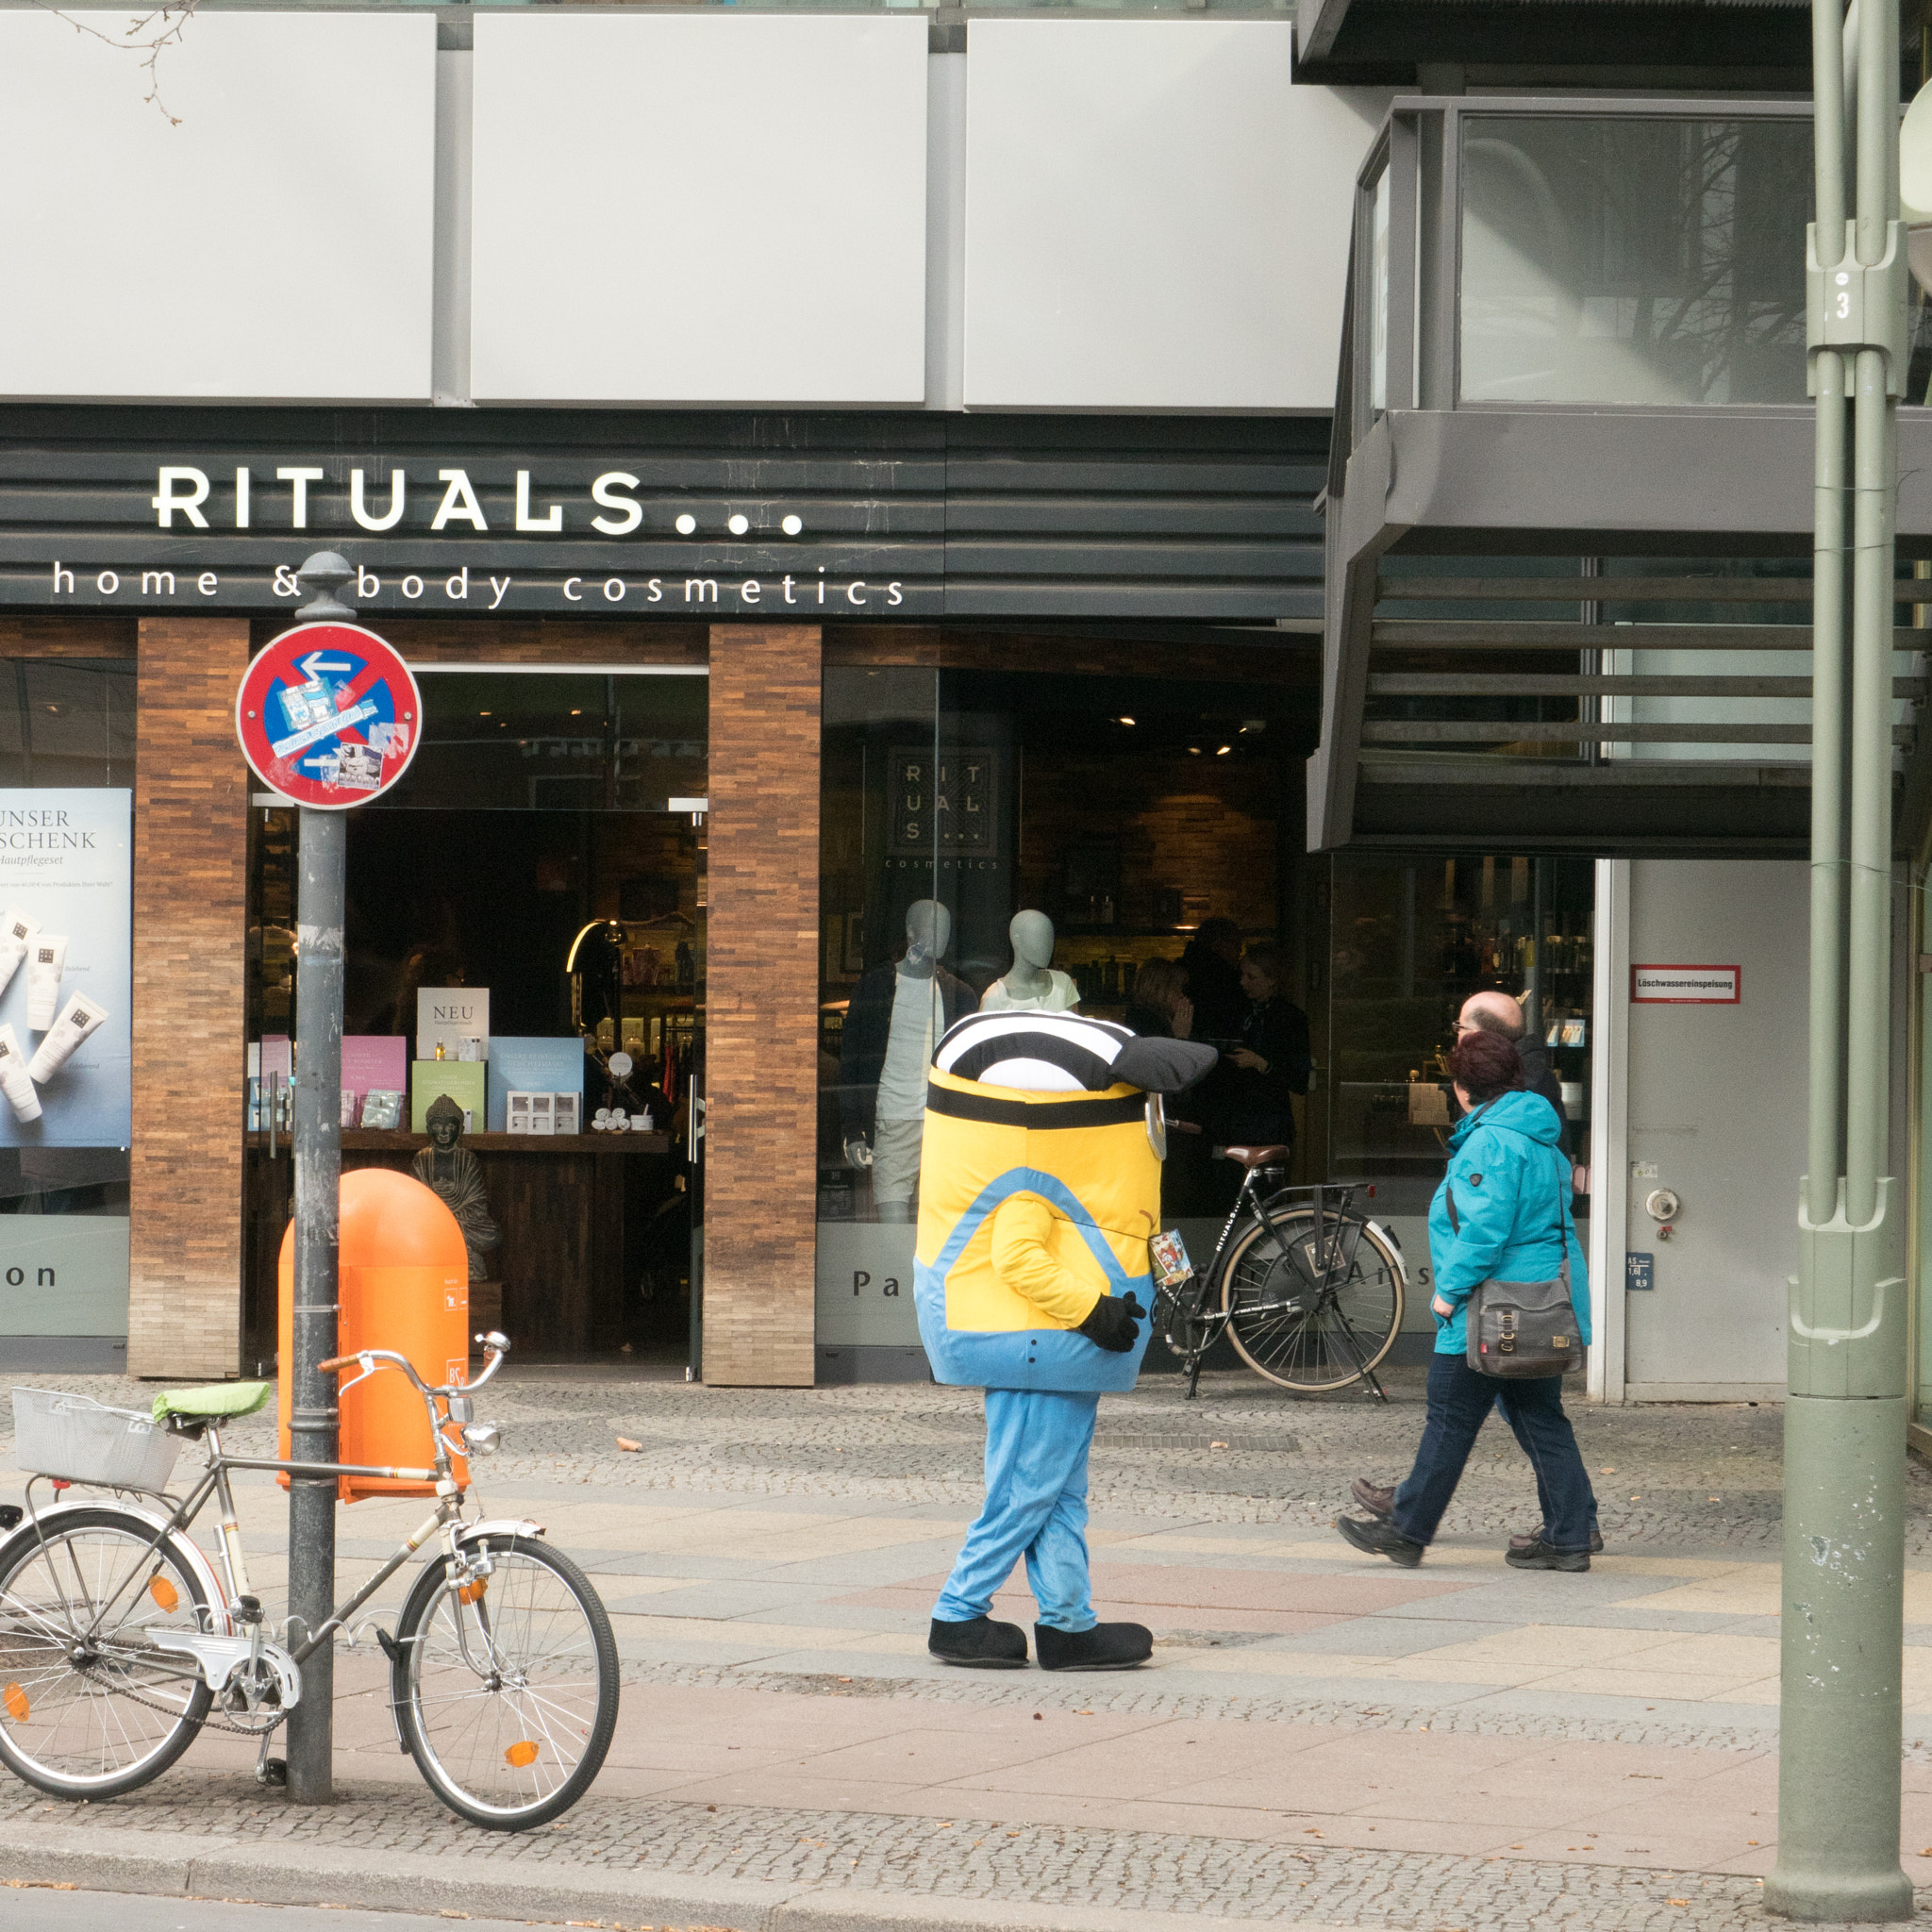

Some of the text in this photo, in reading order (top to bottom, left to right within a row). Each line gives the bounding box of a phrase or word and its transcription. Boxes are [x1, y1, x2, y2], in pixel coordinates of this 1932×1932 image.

[1836, 291, 1849, 319] 3
[54, 560, 903, 610] home & body cosmetics
[885, 858, 997, 870] cosmetics
[1638, 978, 1733, 990] Löschwassereinspeisung
[433, 1006, 474, 1020] NEU
[6, 1267, 55, 1286] on
[1636, 1278, 1648, 1288] 8,9
